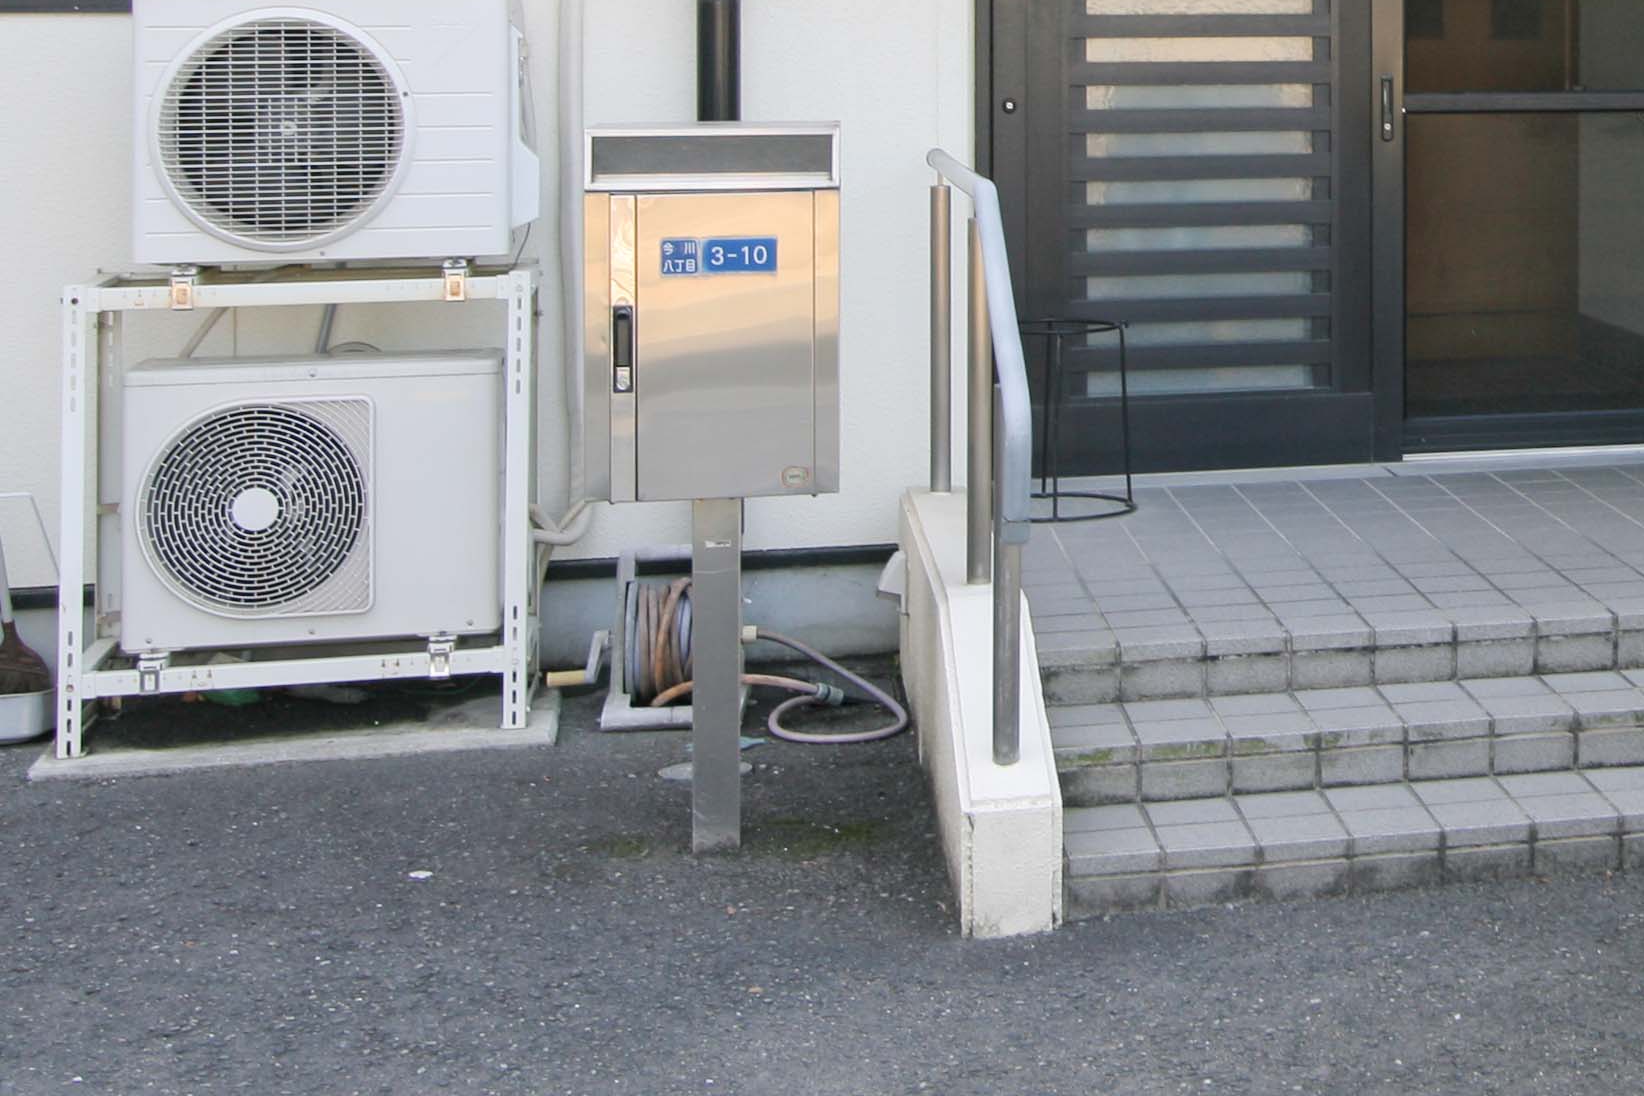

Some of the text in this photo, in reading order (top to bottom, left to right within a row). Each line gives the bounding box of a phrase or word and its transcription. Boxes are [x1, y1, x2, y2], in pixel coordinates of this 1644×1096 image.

[663, 241, 696, 255] 今川
[711, 245, 768, 265] 3-10
[663, 258, 696, 273] 八丁目
